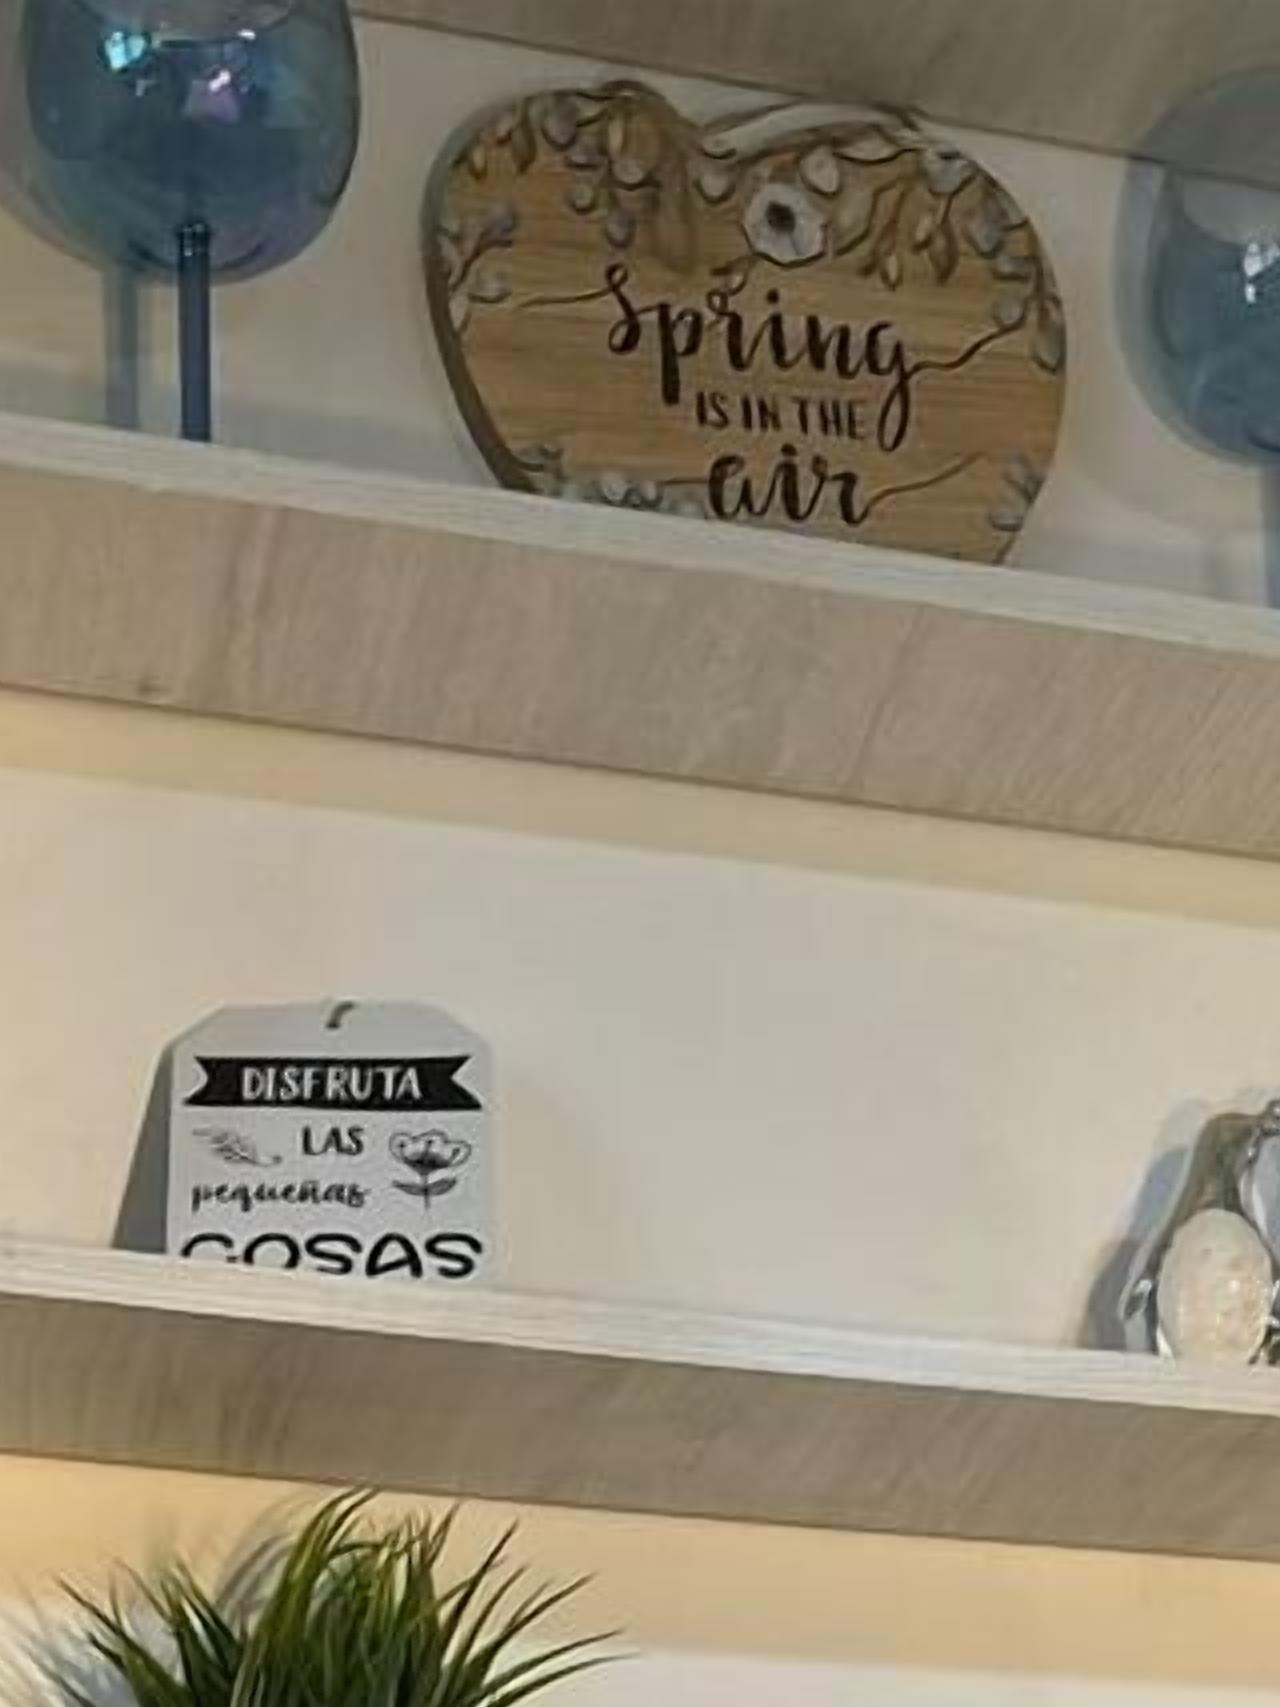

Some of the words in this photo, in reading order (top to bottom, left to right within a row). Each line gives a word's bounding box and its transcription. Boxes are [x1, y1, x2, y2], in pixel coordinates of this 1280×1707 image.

[604, 264, 914, 453] Spring
[697, 391, 729, 428] IS
[741, 394, 782, 432] IN
[792, 396, 866, 440] THE
[708, 443, 871, 526] air
[240, 1064, 422, 1102] DISFRUTA
[300, 1125, 364, 1156] LAS
